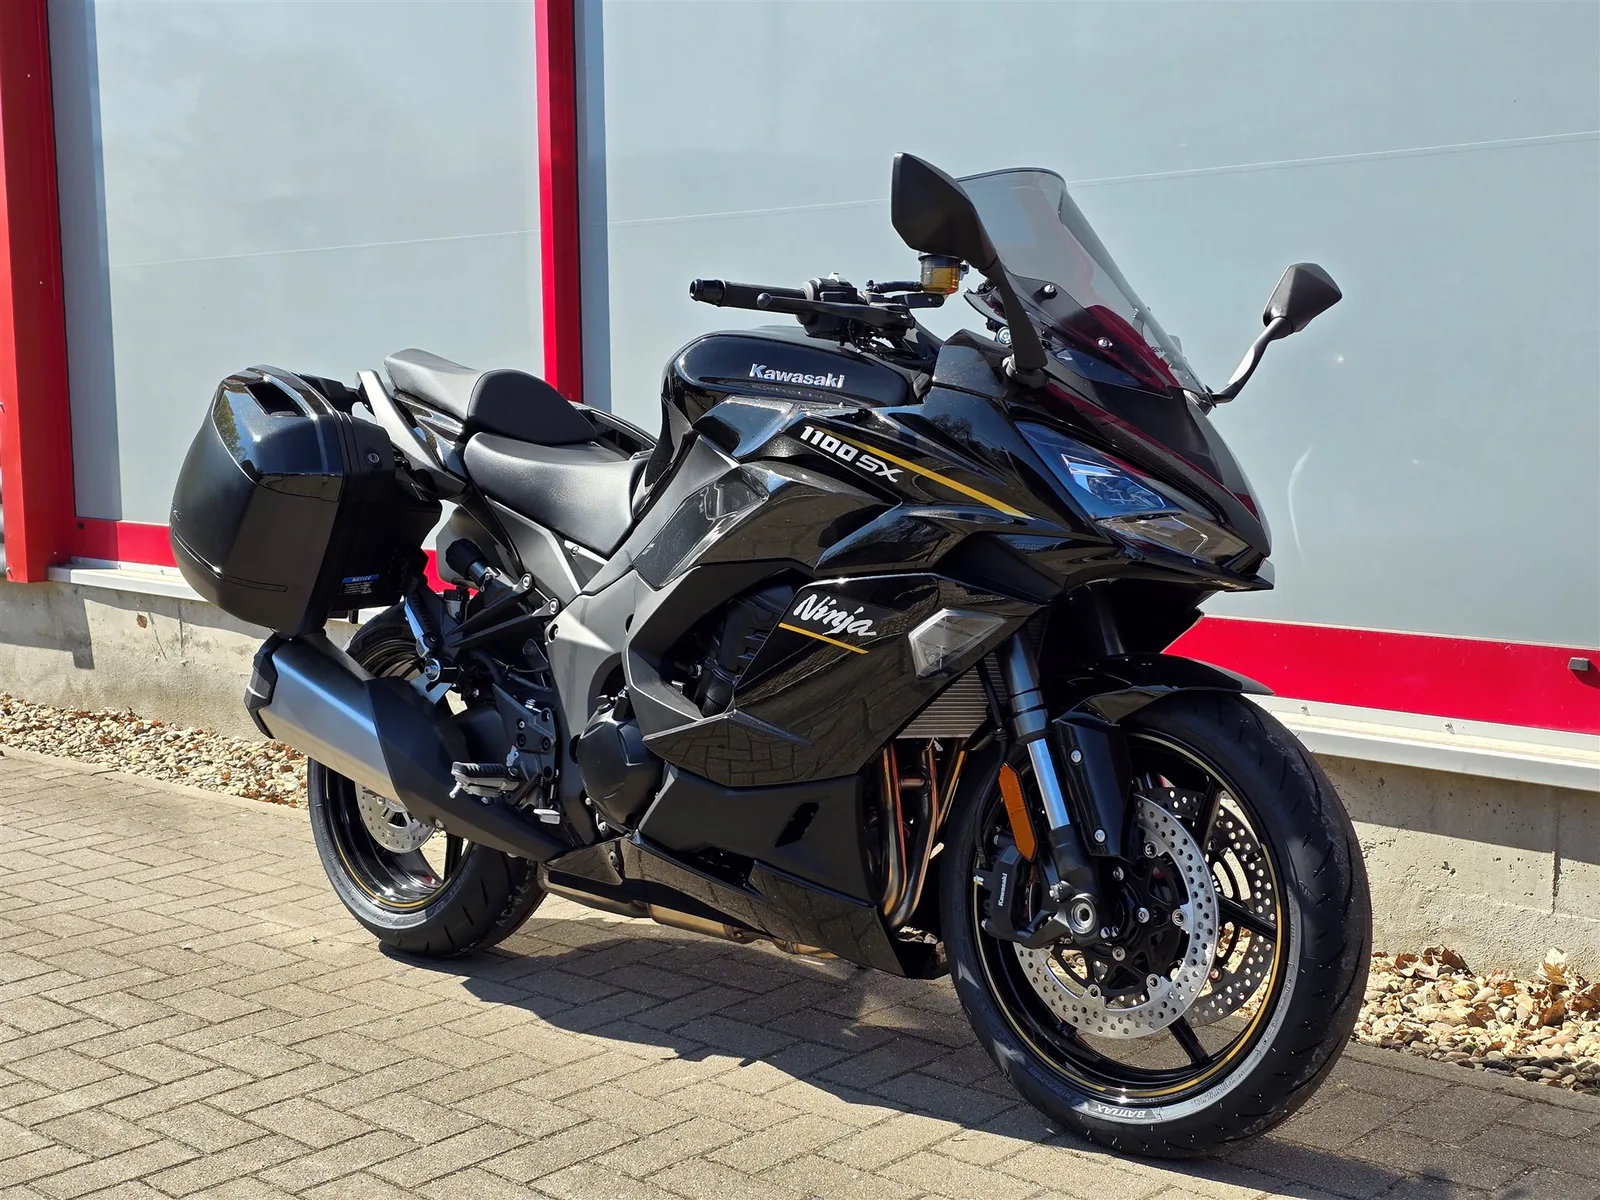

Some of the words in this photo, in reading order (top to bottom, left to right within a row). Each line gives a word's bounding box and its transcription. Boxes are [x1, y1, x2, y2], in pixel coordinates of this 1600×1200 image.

[749, 363, 846, 389] Kawasaki
[800, 425, 854, 462] 1100
[855, 453, 904, 484] SX
[792, 593, 877, 637] Ninja
[997, 872, 1008, 907] Kawasaki
[1093, 1104, 1147, 1119] BATTLAX
